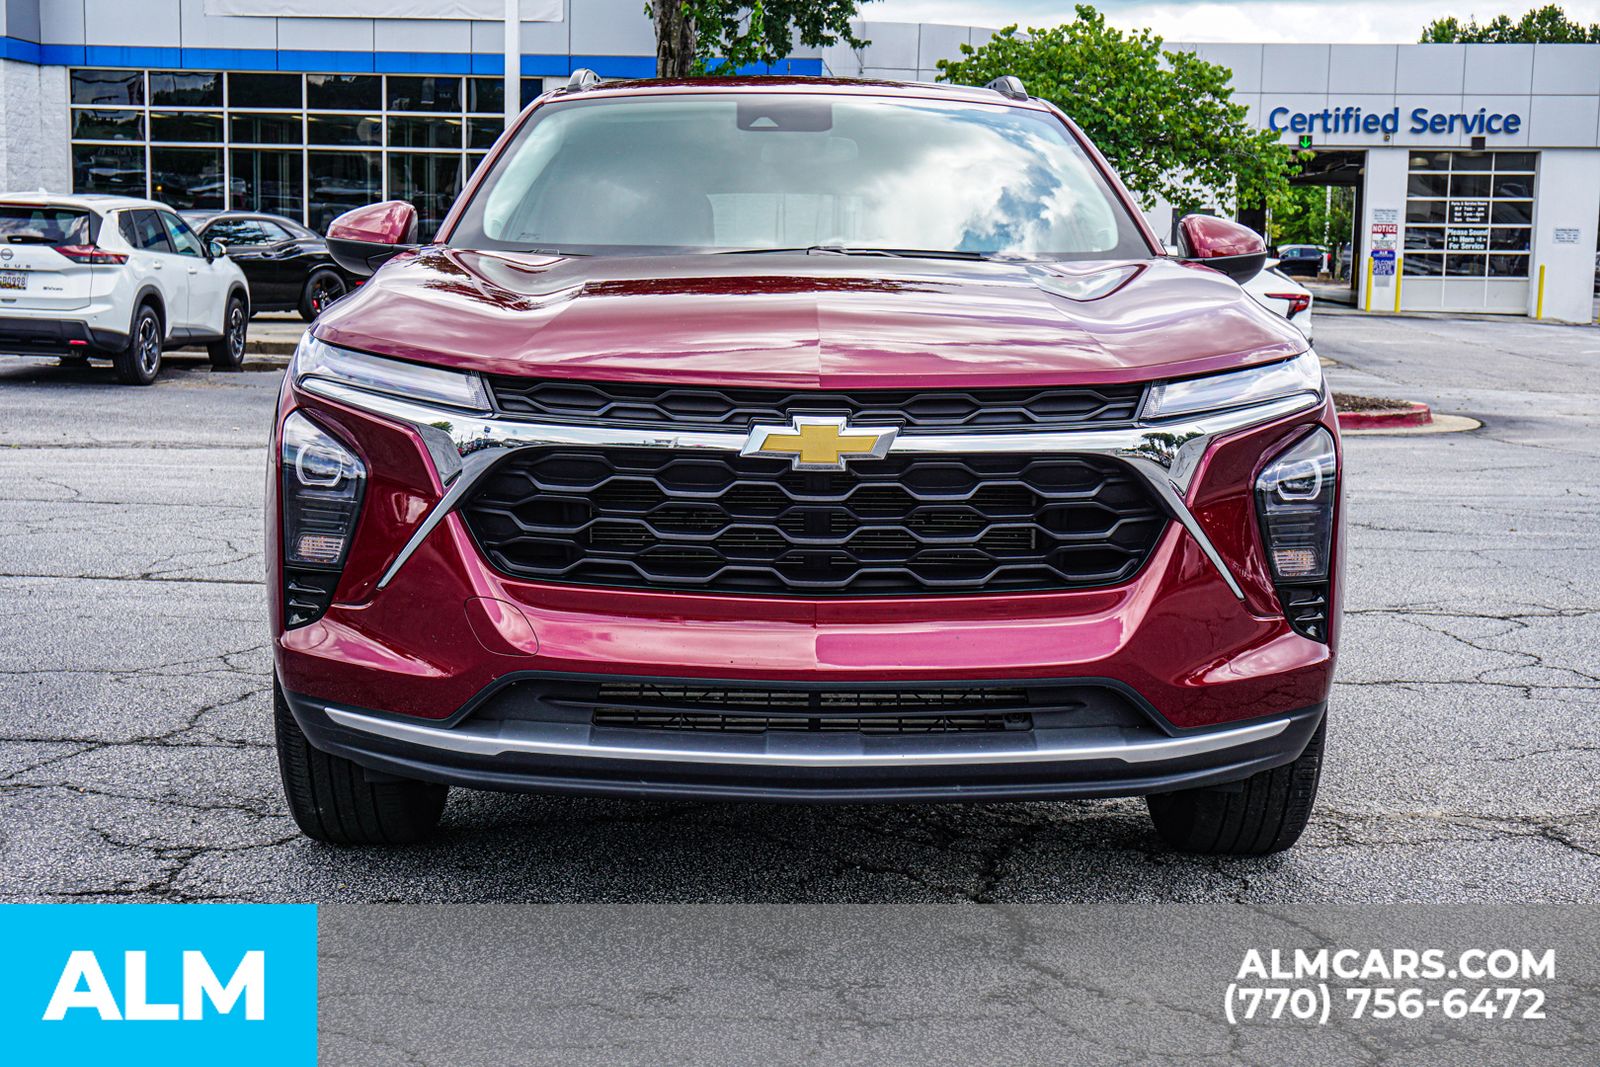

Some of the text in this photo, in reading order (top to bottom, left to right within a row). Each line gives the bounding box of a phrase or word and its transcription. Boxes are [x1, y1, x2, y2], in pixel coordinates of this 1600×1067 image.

[1269, 106, 1521, 134] Certified Service
[1372, 225, 1397, 233] NOTICE
[1447, 228, 1489, 236] Please Sound
[1448, 242, 1485, 250] For Service
